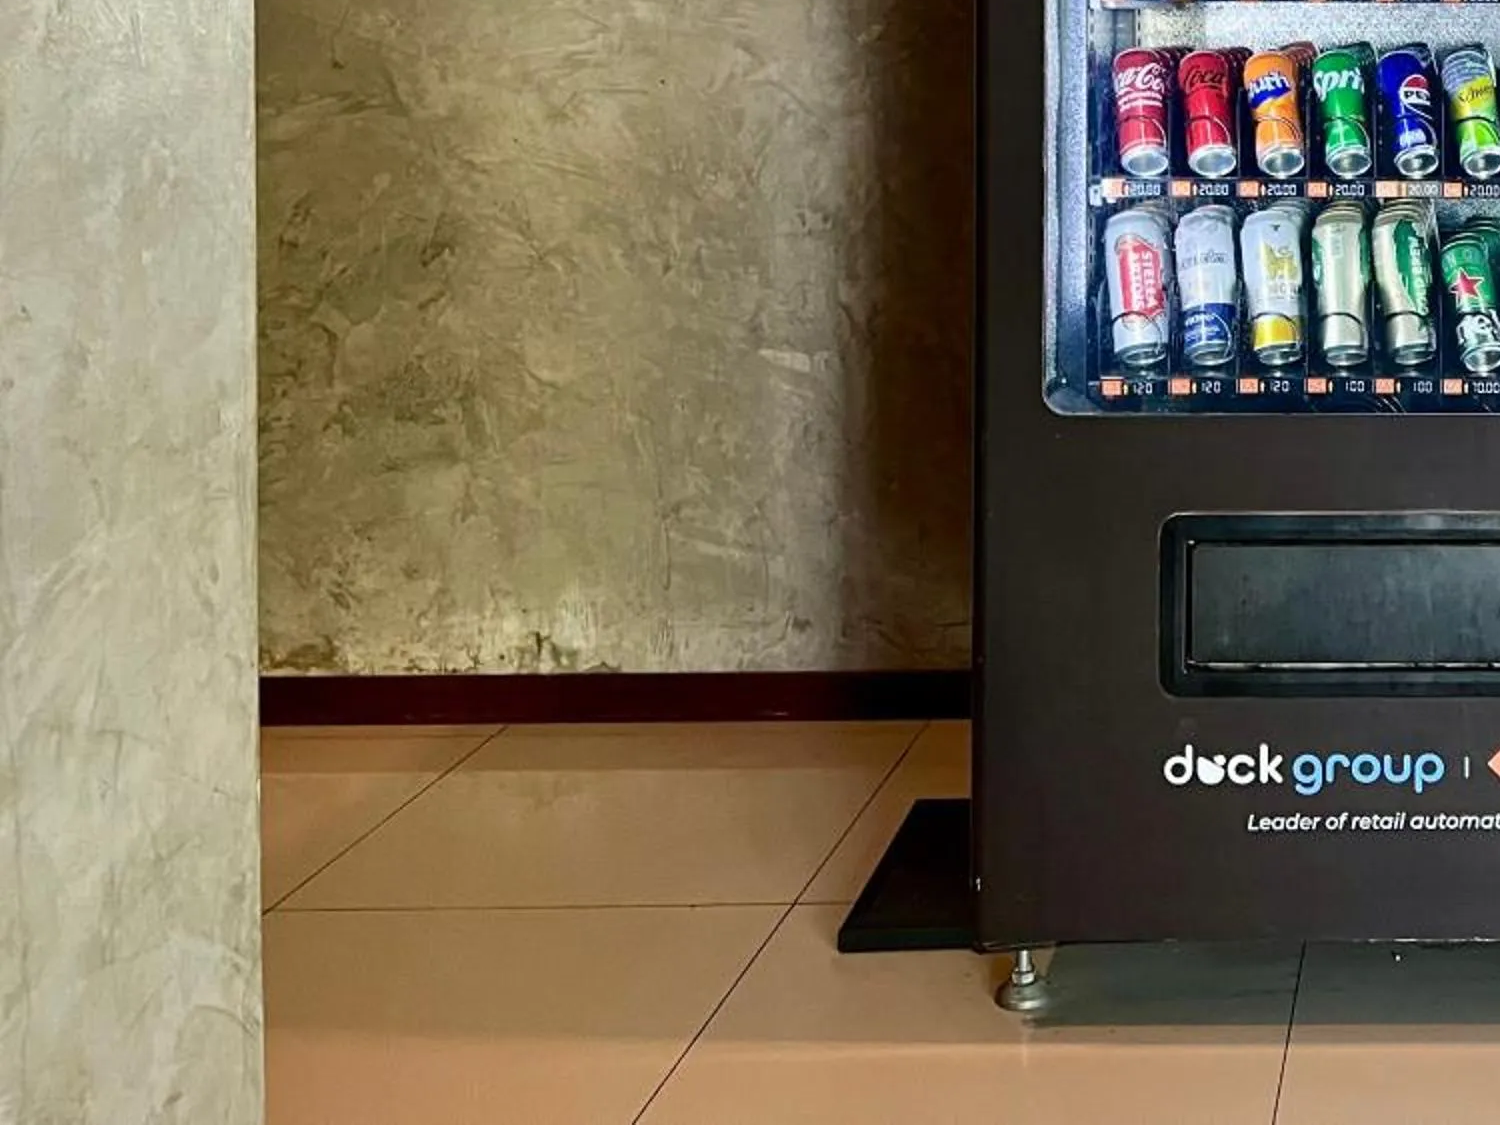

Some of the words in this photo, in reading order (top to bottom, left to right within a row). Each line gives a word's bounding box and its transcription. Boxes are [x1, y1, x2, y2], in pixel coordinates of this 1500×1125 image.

[1292, 753, 1446, 795] group
[1247, 811, 1321, 832] Leader
[1325, 811, 1347, 831] of
[1350, 811, 1407, 831] retail
